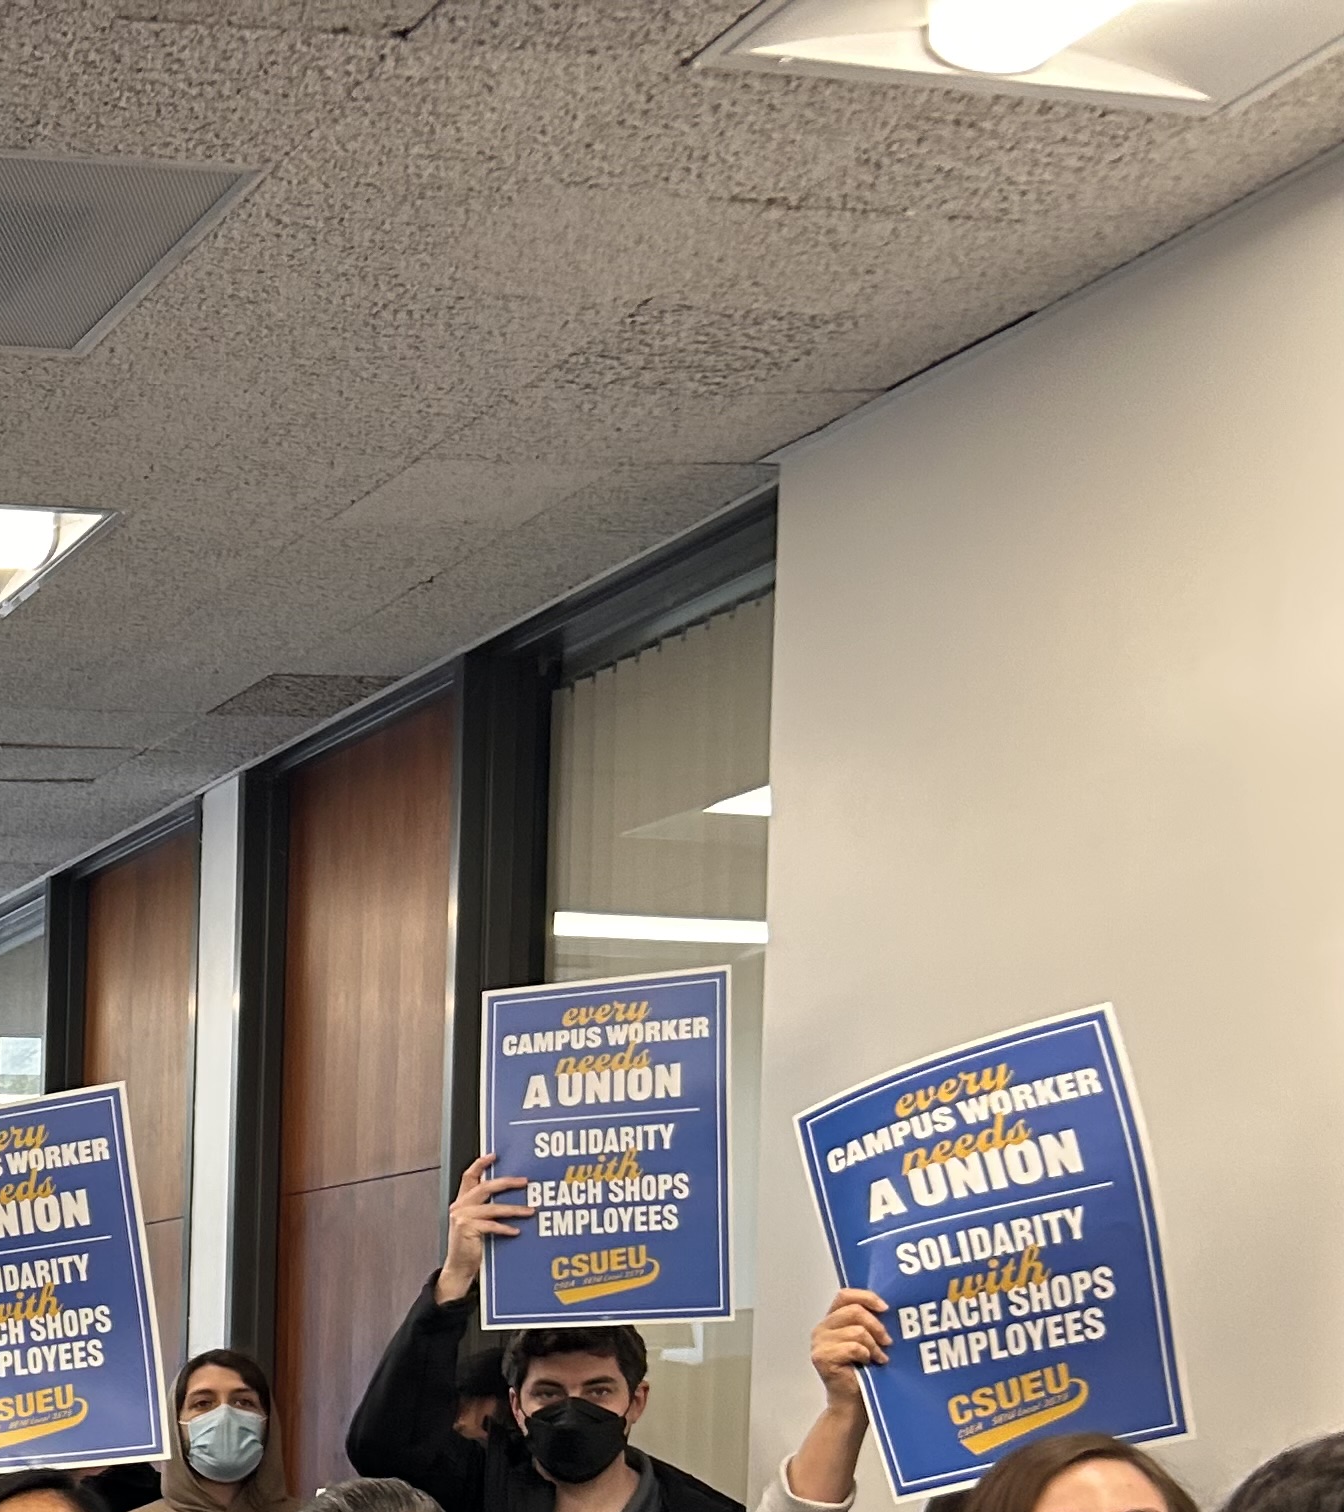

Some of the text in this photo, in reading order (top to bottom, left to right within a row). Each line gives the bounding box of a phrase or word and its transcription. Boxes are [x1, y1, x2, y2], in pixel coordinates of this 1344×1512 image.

[562, 1000, 652, 1028] every
[502, 1016, 710, 1056] CAMPUS WORKER
[555, 1041, 651, 1076] needs
[522, 1063, 682, 1109] A UNION
[894, 1062, 1016, 1118] every
[534, 1123, 675, 1158] SOLIDARITY
[827, 1067, 1103, 1174] CAMPUS WORKER
[7, 1138, 110, 1176] WORKER
[565, 1148, 643, 1183] with
[901, 1113, 1033, 1176] needs
[527, 1173, 690, 1208] BEACH SHOPS
[868, 1128, 1085, 1224] A UNION
[538, 1205, 680, 1238] EMPLOYEES
[896, 1206, 1084, 1275] SOLIDARITY
[552, 1244, 647, 1281] CSUEU
[946, 1244, 1051, 1302] with
[30, 1305, 112, 1341] SHOPS
[898, 1267, 1116, 1341] BEACH SHOPS
[920, 1307, 1106, 1377] EMPLOYEES
[947, 1362, 1071, 1426] CSUEU
